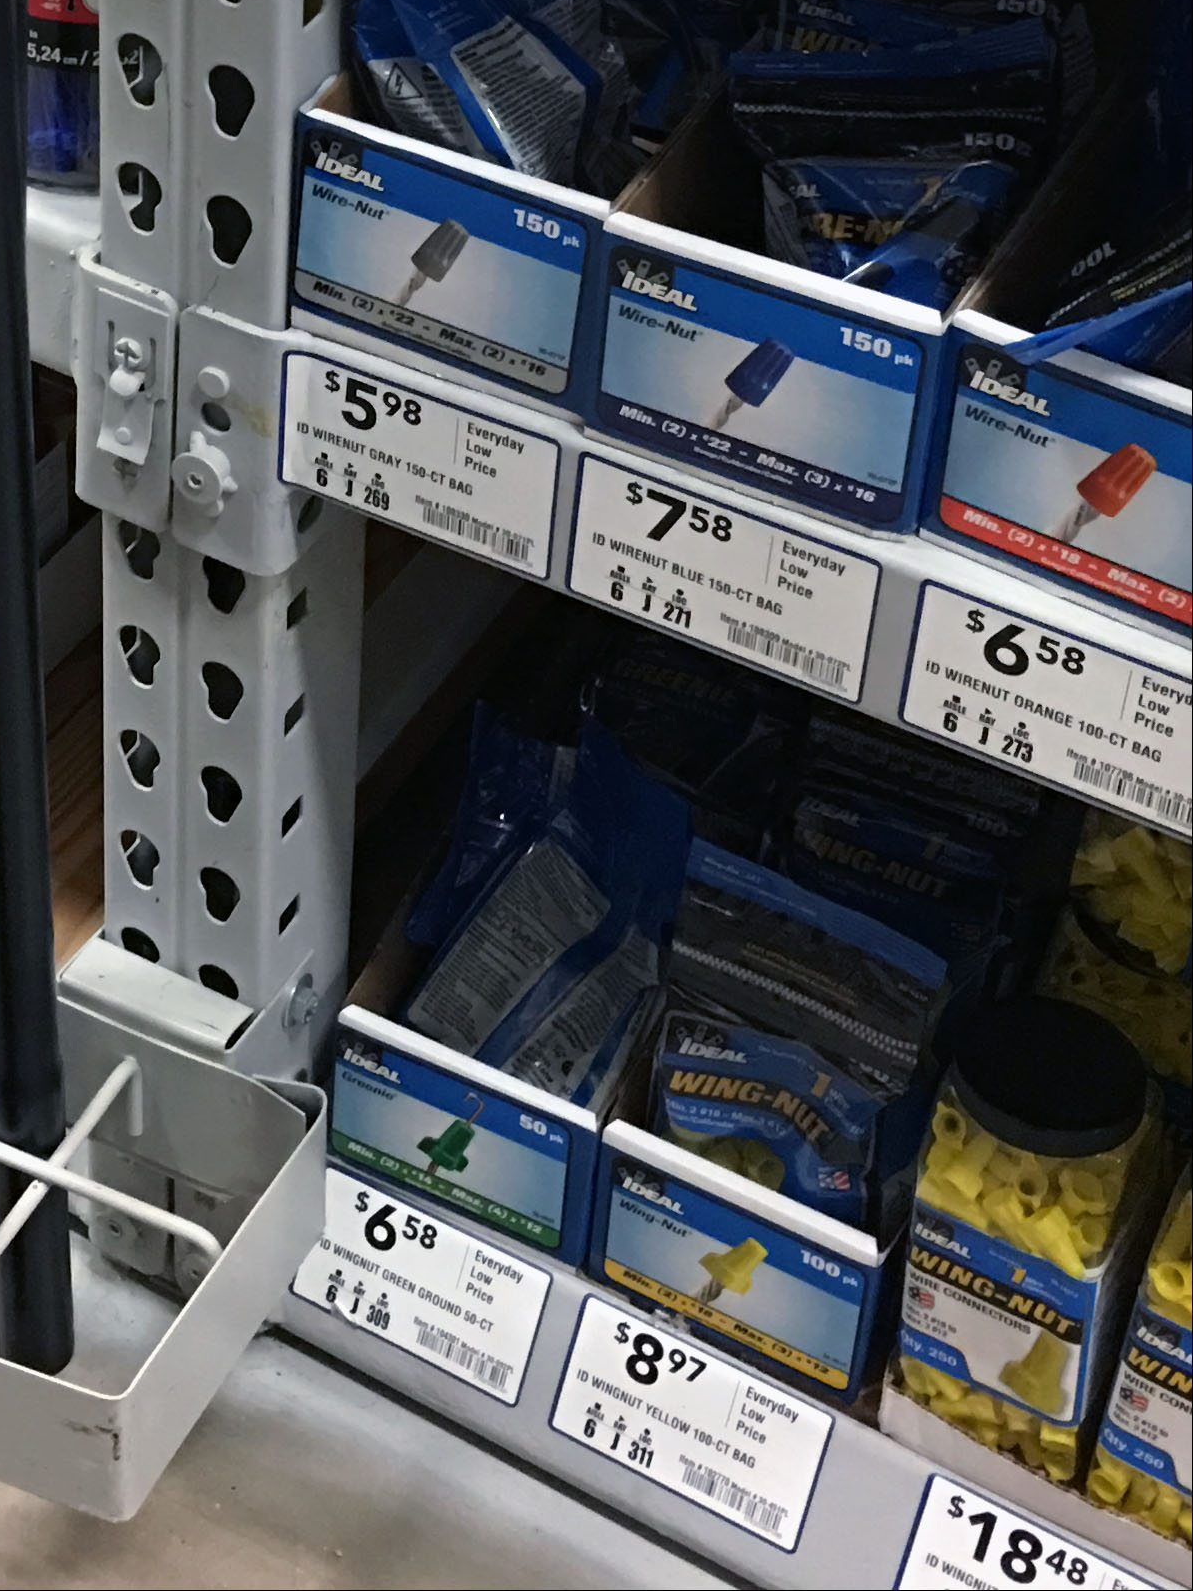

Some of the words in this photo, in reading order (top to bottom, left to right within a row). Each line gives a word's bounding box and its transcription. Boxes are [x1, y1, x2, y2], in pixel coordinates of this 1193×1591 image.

[315, 152, 384, 191] IDEAL
[514, 208, 561, 239] 150
[621, 271, 697, 312] IDEAL
[313, 281, 346, 302] Min.
[439, 328, 477, 351] Max.
[839, 326, 892, 358] 150
[969, 370, 1050, 417] IDEAL
[466, 440, 491, 458] Low
[468, 423, 525, 455] Everyday
[619, 404, 657, 427] Min.
[757, 452, 799, 477] Max.
[297, 422, 309, 434] ID
[313, 427, 366, 456] WIRENUT
[369, 448, 402, 469] GRAY
[406, 461, 446, 486] 150-CT
[449, 479, 473, 496] BAG
[465, 457, 497, 478] Price
[365, 487, 389, 510] 269
[782, 540, 846, 576] Everyday
[963, 509, 1002, 534] Min.
[1107, 567, 1152, 594] Max.
[592, 532, 606, 546] ID
[610, 538, 668, 570] WIRENUT
[671, 563, 704, 585] BLUE
[708, 579, 752, 603] 150-CT
[756, 597, 783, 616] BAG
[780, 559, 807, 579] Low
[777, 576, 813, 599] Price
[926, 660, 940, 674] ID
[945, 668, 1010, 702] WIRENUT
[1014, 695, 1073, 727] ORANGE
[1078, 720, 1128, 749] 100-CT
[1133, 741, 1162, 763] BAG
[1138, 695, 1170, 716] Low
[1133, 712, 1174, 738] Price
[1002, 735, 1033, 763] 273
[669, 1071, 831, 1144] WING-NUT
[519, 1113, 547, 1137] 50
[622, 1177, 684, 1215] IDEAL
[914, 1223, 971, 1260] IDEAL
[470, 1267, 492, 1285] Low
[475, 1250, 524, 1283] Everyday
[801, 1249, 840, 1278] 100
[333, 1244, 380, 1275] WINGNUT
[382, 1267, 416, 1294] GREEN
[418, 1286, 462, 1317] GROUND
[463, 1311, 494, 1333] 50-CT
[466, 1285, 494, 1305] Price
[909, 1270, 941, 1296] WIRE
[942, 1287, 1031, 1334] CONNECTORS
[910, 1246, 1080, 1334] WING-NUT
[367, 1305, 391, 1330] 309
[901, 1332, 924, 1354] Qty.
[928, 1346, 957, 1367] 250
[1123, 1371, 1156, 1397] WIRE
[576, 1369, 589, 1383] ID
[591, 1374, 643, 1410] WINGNUT
[646, 1402, 691, 1434] YELLOW
[694, 1428, 730, 1454] 100-CT
[732, 1449, 756, 1469] BAG
[741, 1404, 766, 1425] Low
[745, 1386, 799, 1423] Everyday
[736, 1421, 766, 1445] Price
[628, 1441, 654, 1468] 311
[925, 1553, 937, 1568] ID
